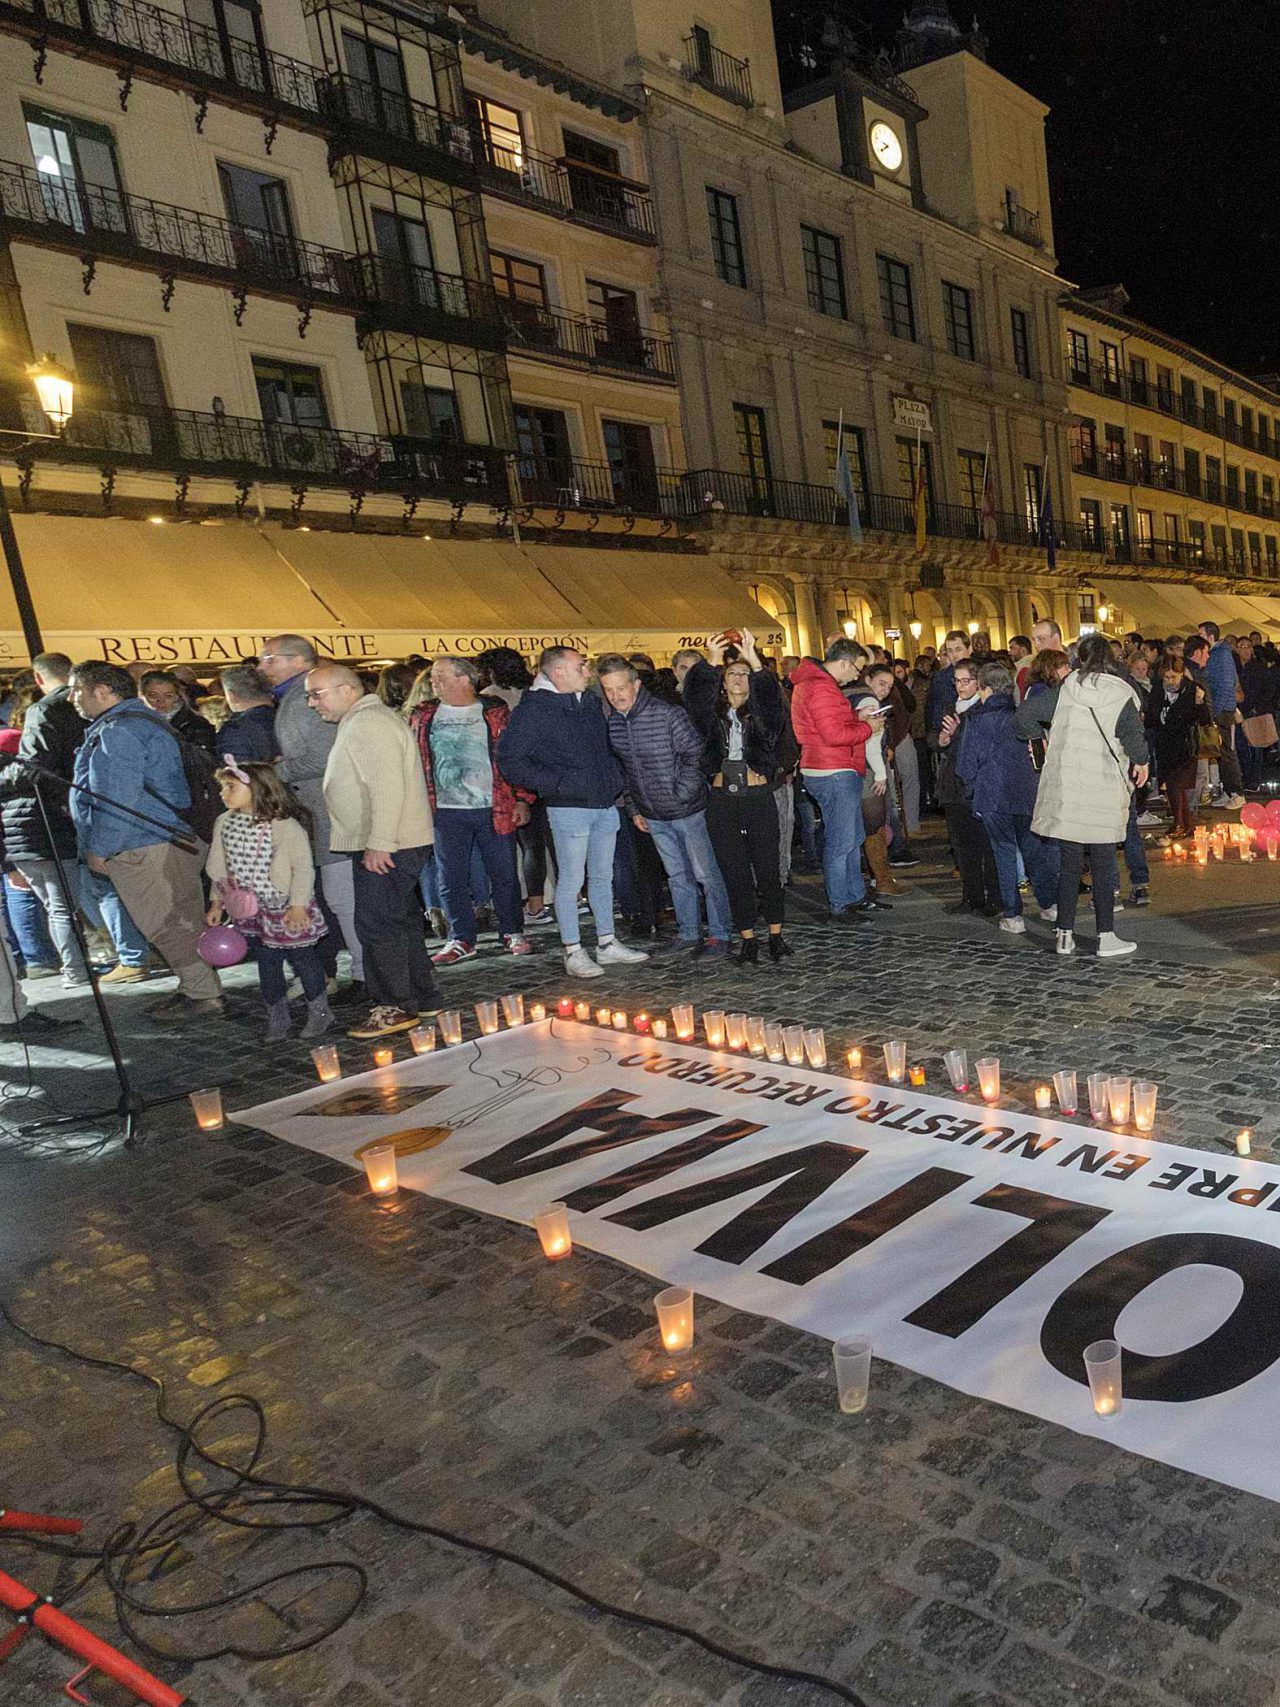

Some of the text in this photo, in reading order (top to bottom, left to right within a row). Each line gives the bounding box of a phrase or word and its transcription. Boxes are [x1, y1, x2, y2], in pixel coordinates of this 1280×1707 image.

[898, 400, 926, 414] PLAZA
[900, 415, 927, 428] MAYOR
[99, 634, 379, 662] RESTAUNTE
[421, 633, 590, 653] LA CONCEPCIÓN
[767, 632, 783, 645] 25
[616, 1051, 834, 1106] RECUERDO
[823, 1094, 1062, 1160] NUESTRO
[1057, 1142, 1151, 1182] EN
